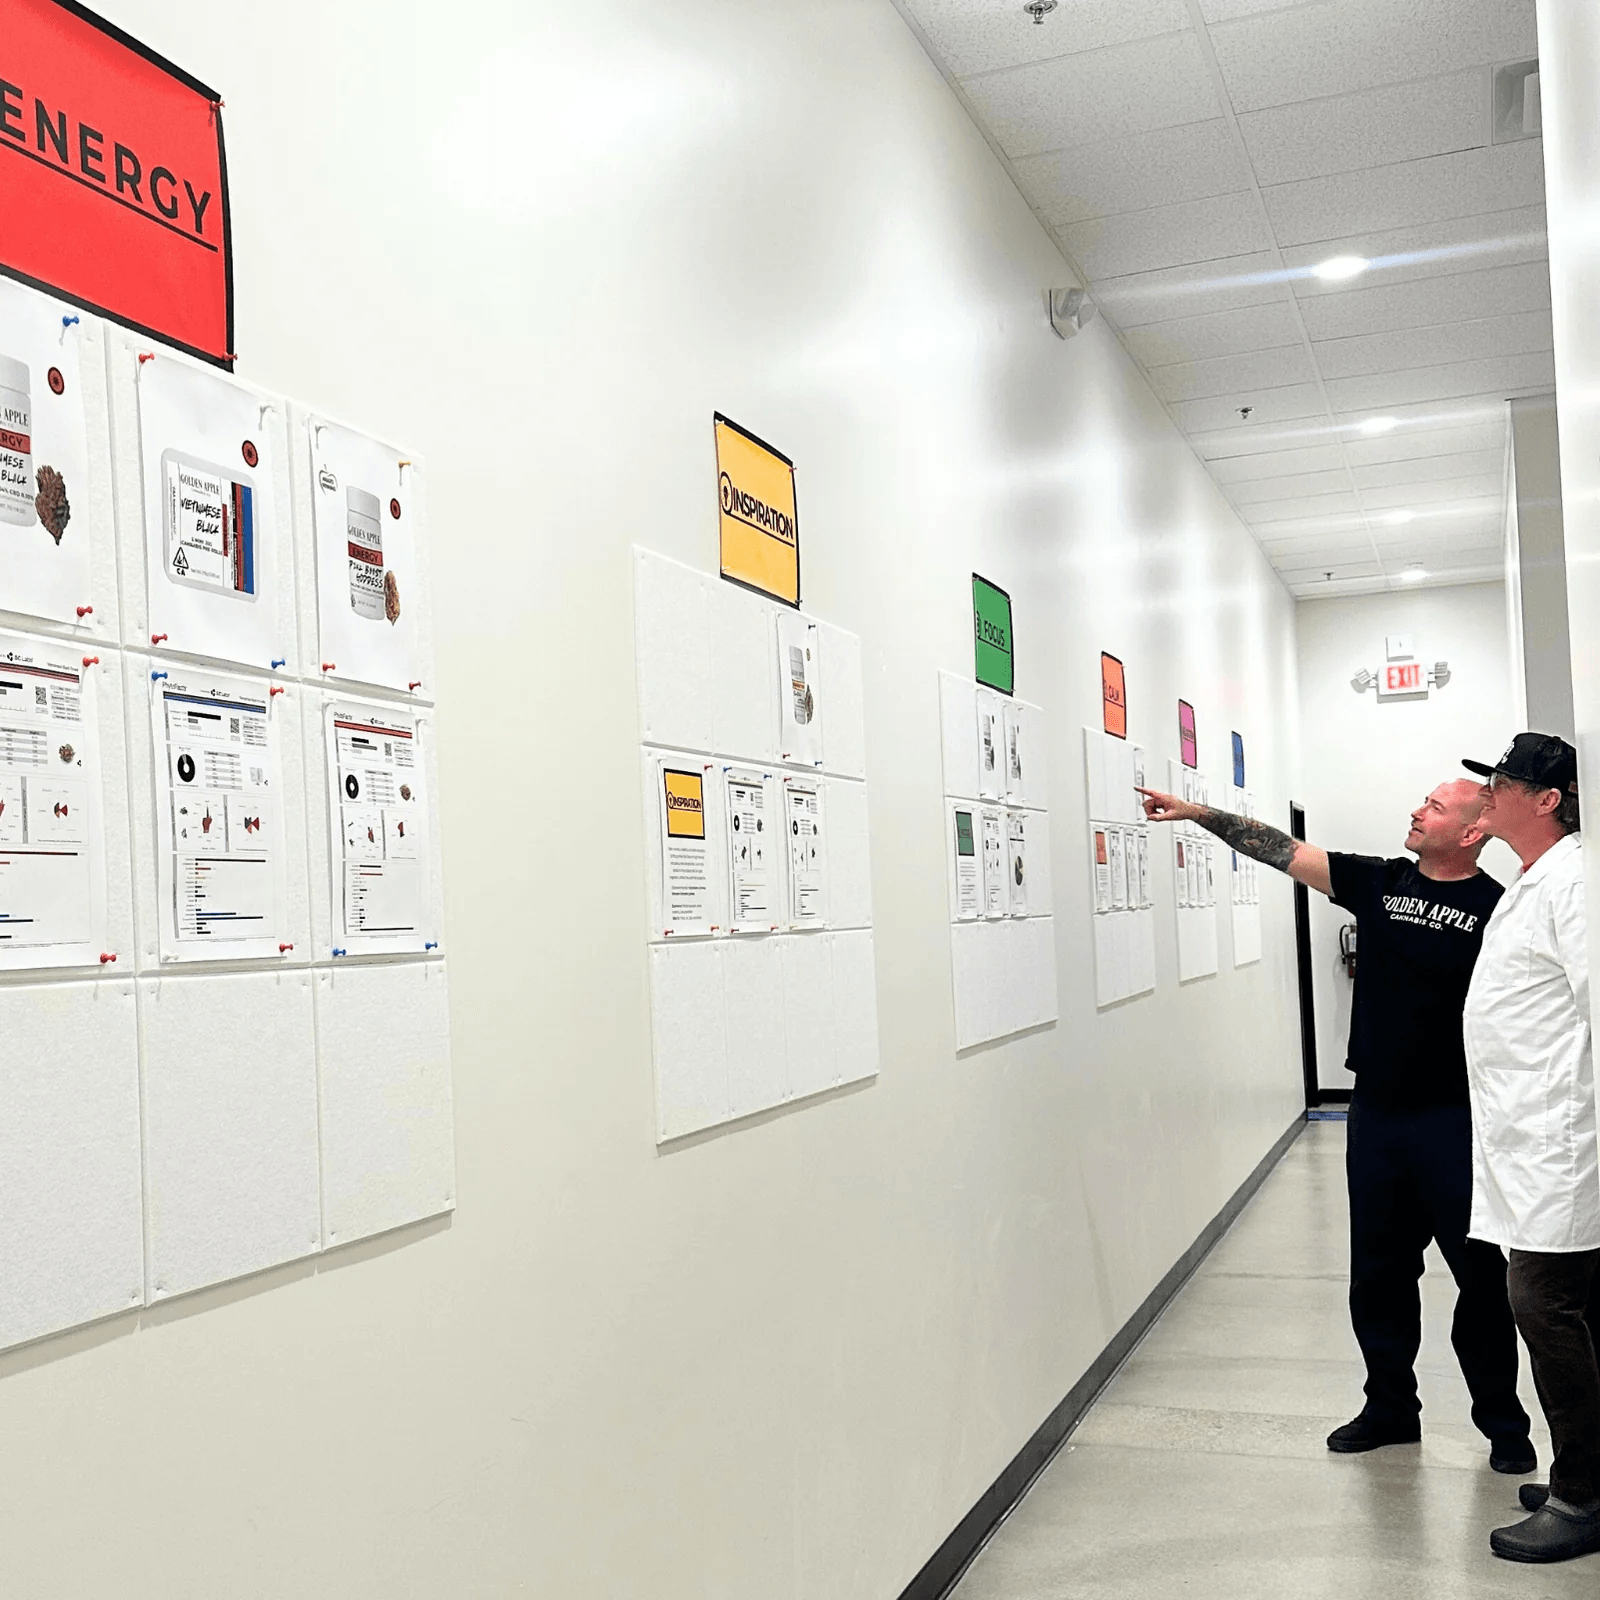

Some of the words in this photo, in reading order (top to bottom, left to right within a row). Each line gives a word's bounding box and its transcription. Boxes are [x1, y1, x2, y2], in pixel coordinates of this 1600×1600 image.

[0, 77, 211, 235] ENERGY
[4, 407, 29, 427] APPLE
[0, 430, 22, 448] RGY
[180, 473, 203, 489] GOLDEN
[732, 486, 794, 540] INSPIRATION
[352, 547, 379, 563] ENERGY
[176, 567, 186, 576] CA
[984, 619, 1006, 647] FOCUS
[1387, 664, 1420, 690] EXIT
[1382, 895, 1429, 916] GOLDEN
[1427, 903, 1478, 932] APPLE
[1390, 913, 1427, 925] CANNABIS
[1429, 921, 1444, 931] CO.
